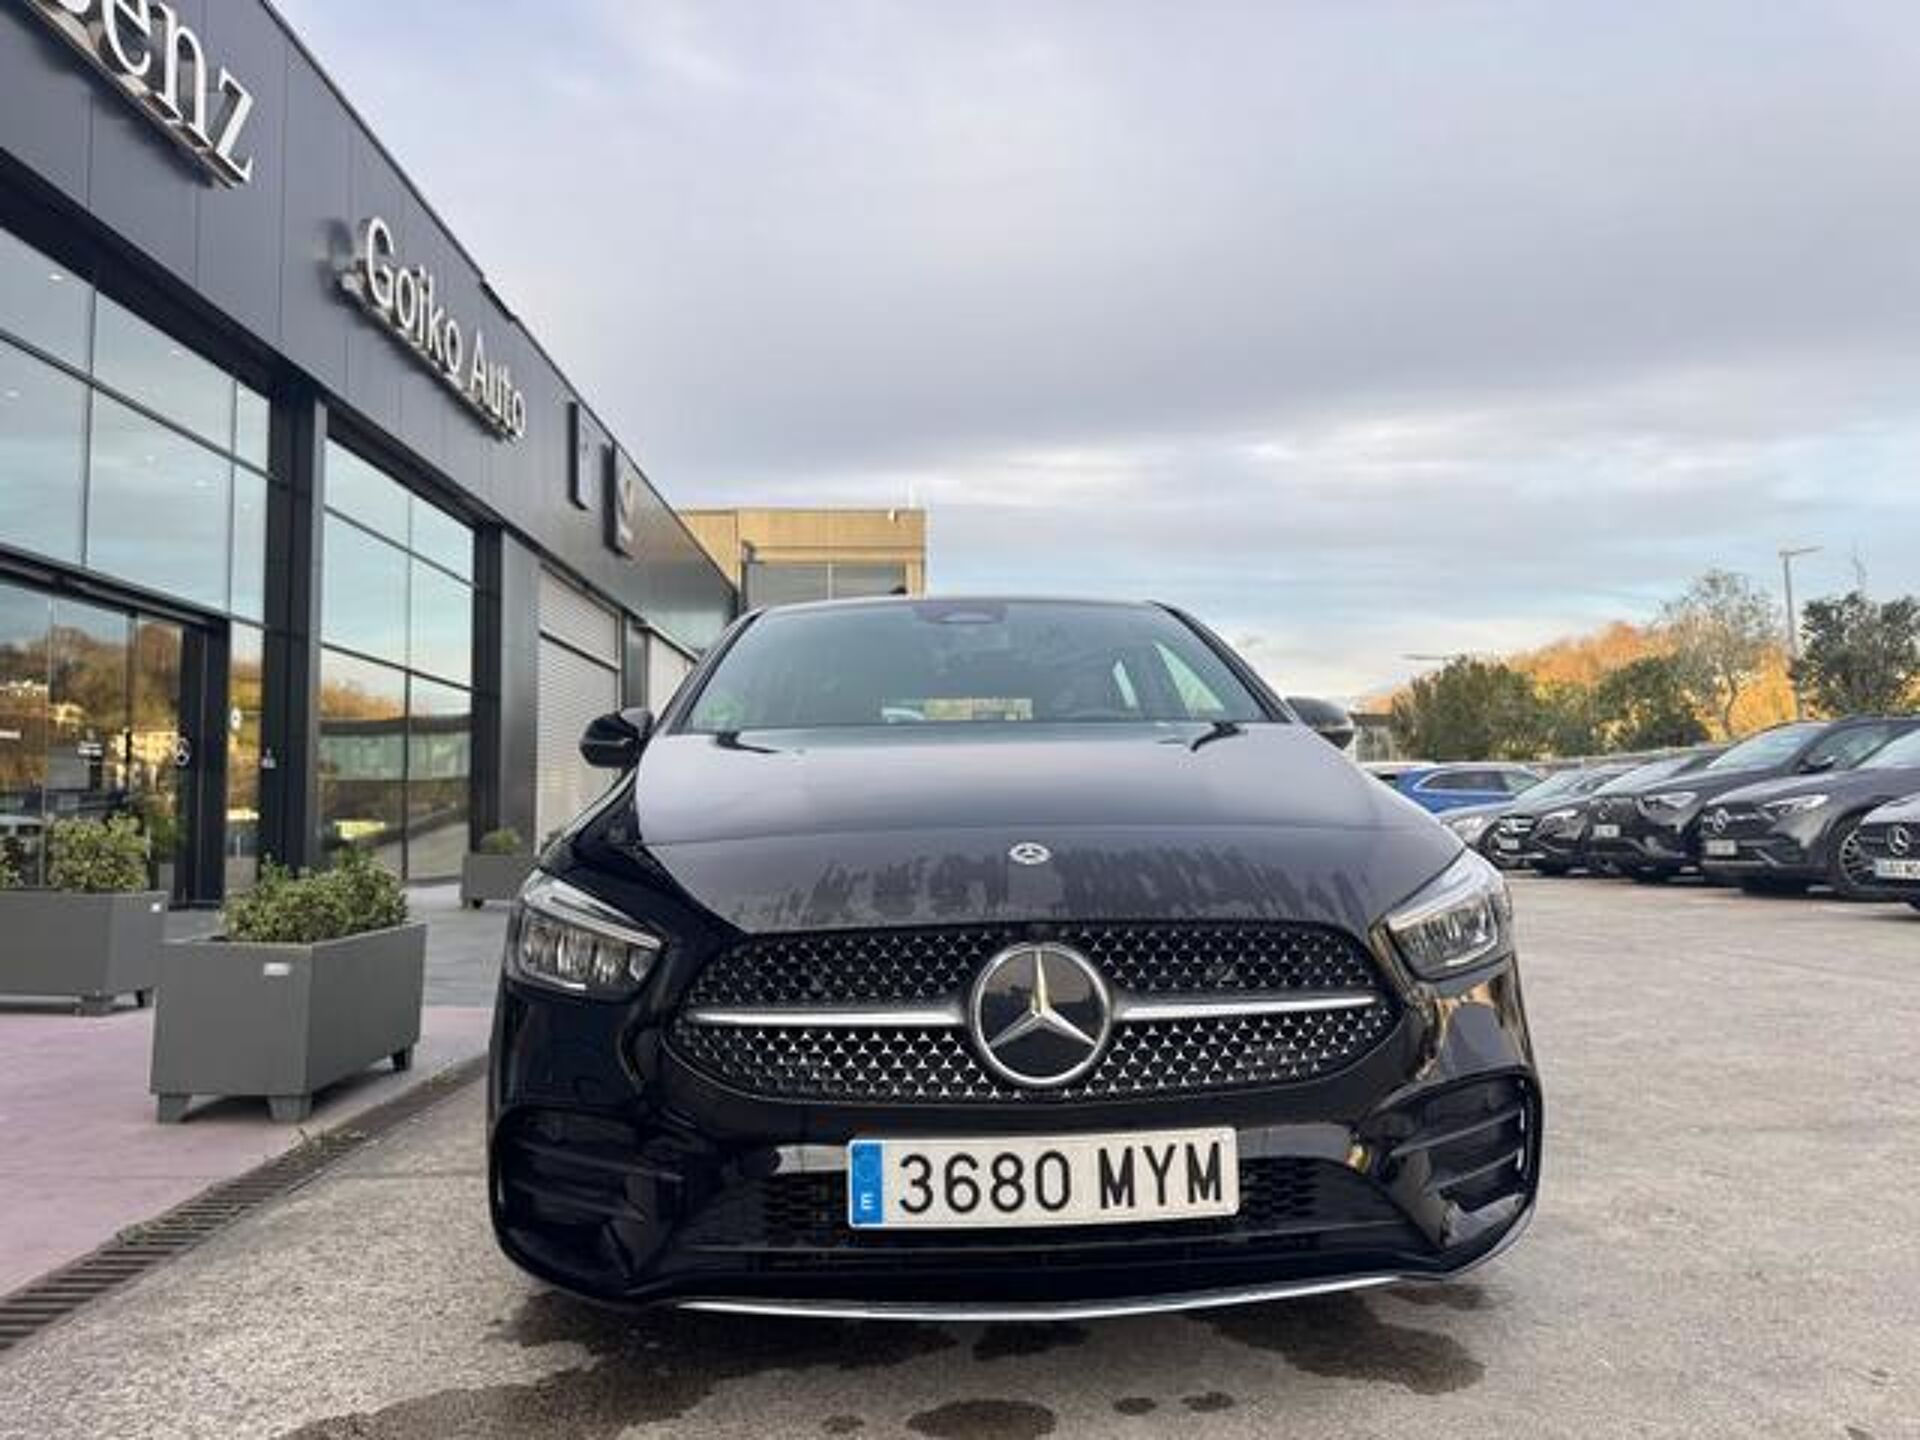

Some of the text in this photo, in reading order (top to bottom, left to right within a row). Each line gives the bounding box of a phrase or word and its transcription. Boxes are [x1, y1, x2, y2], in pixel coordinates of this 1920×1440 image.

[55, 0, 253, 182] enz
[367, 216, 526, 438] Goiko Auto
[860, 1141, 1223, 1213] E 3680 MYM
